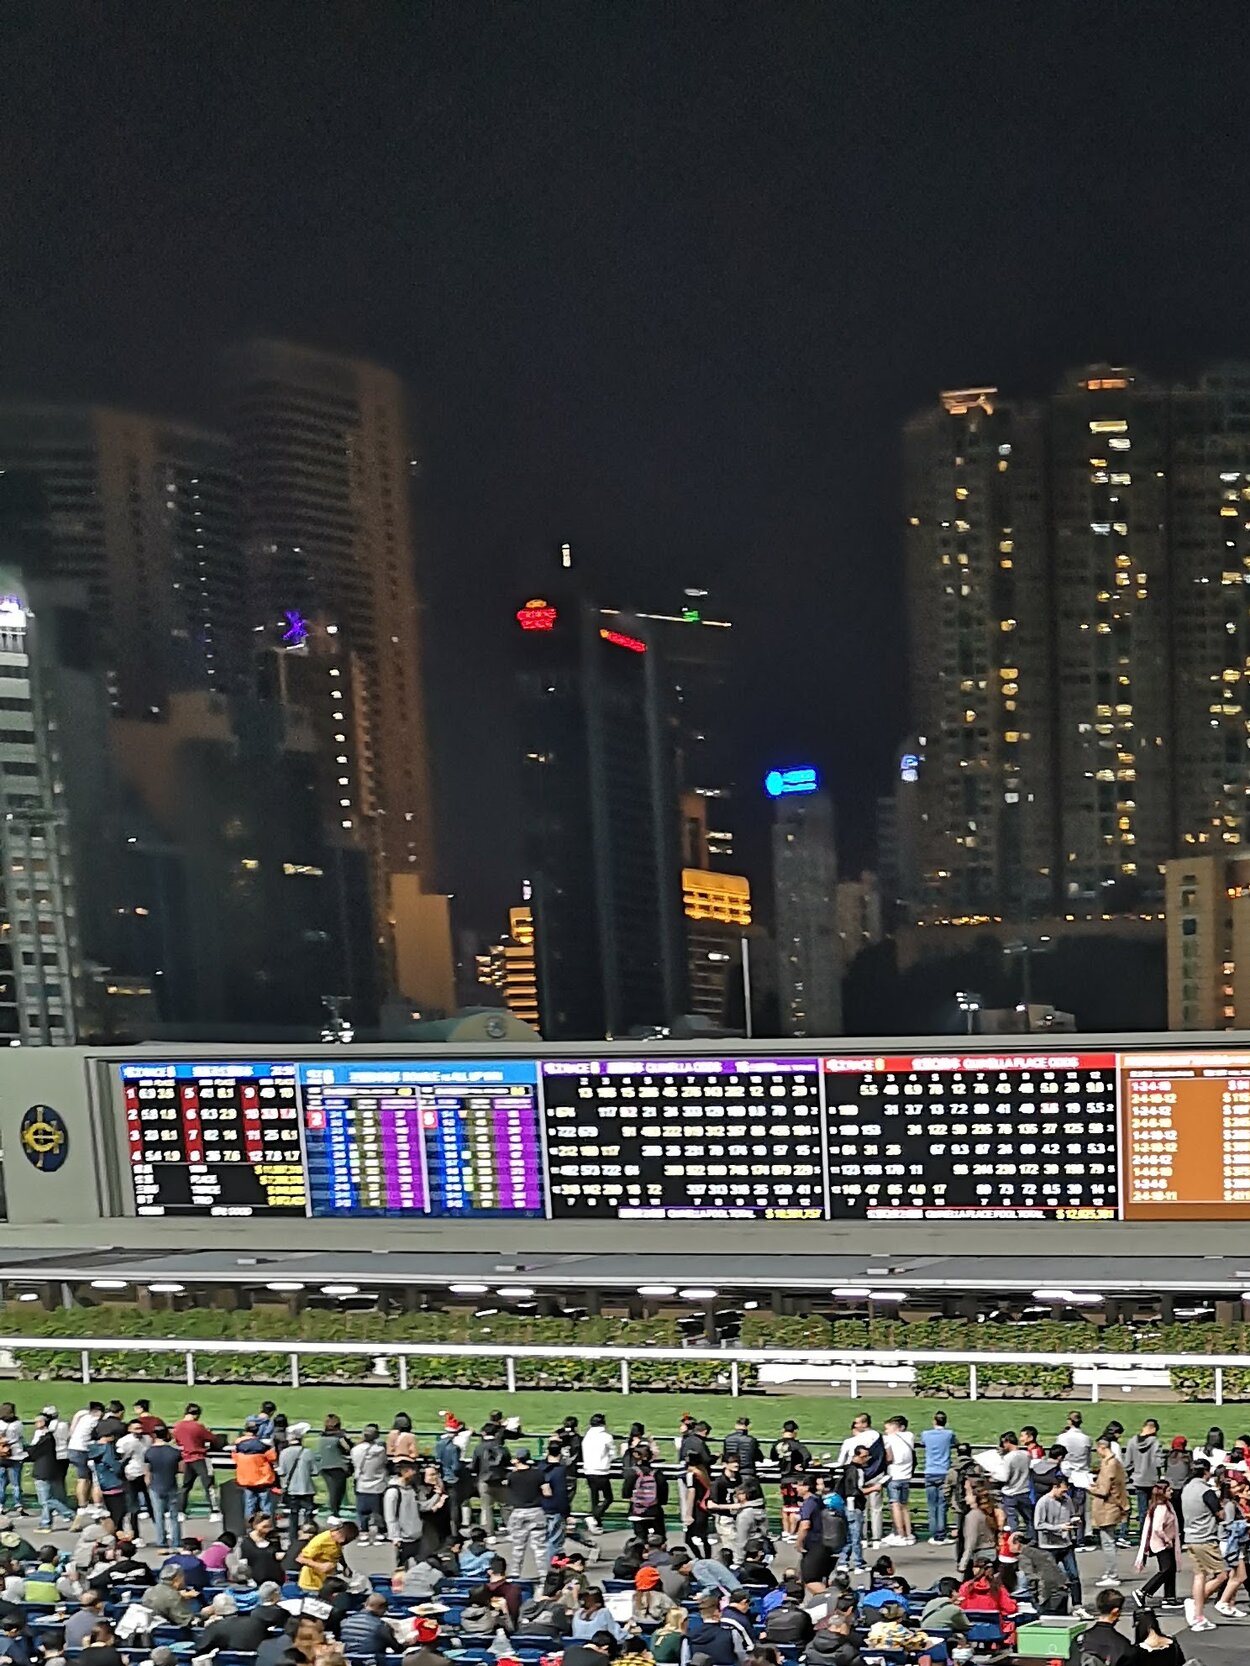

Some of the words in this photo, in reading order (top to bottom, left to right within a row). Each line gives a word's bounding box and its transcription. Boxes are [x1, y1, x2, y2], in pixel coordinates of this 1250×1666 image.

[126, 1088, 135, 1098] 1
[184, 1088, 194, 1098] 5
[243, 1088, 255, 1098] 9
[127, 1109, 138, 1120] 2
[185, 1109, 196, 1119] 6
[129, 1130, 140, 1140] 3
[187, 1130, 198, 1140] 7
[131, 1151, 141, 1160] 4
